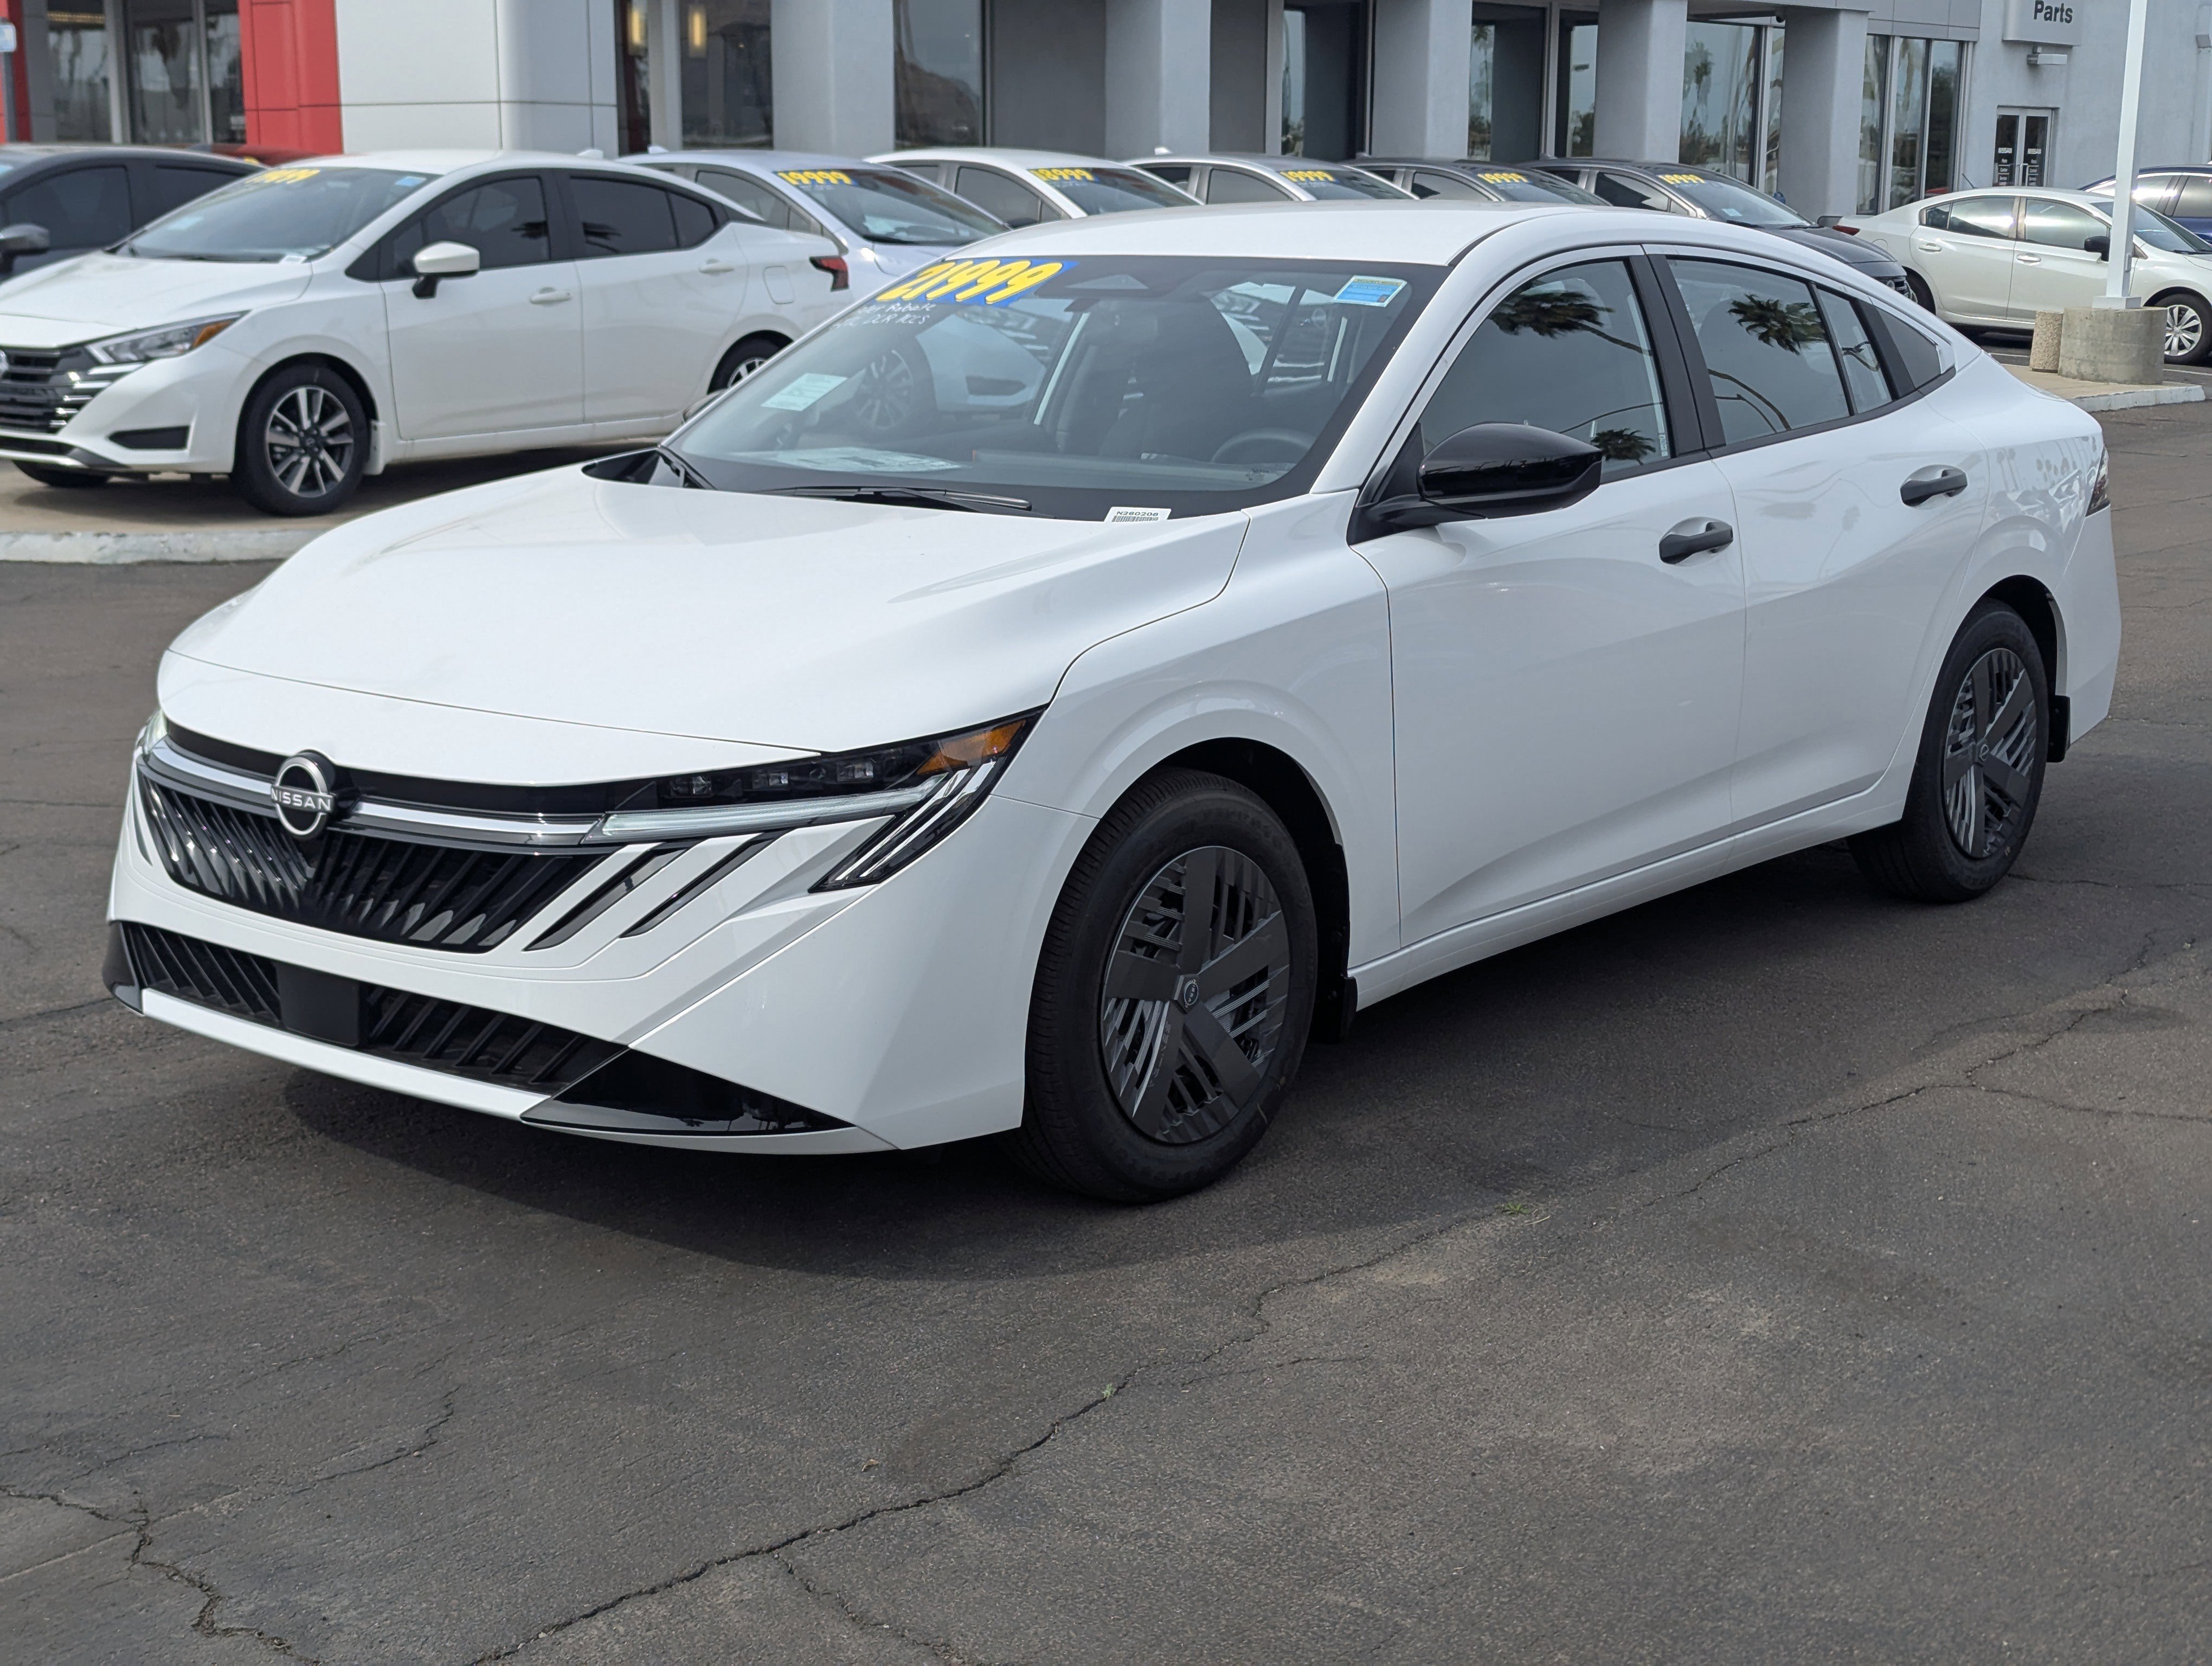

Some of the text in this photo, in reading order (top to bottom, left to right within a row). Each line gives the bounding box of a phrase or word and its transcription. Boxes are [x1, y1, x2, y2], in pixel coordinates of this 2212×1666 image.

[2034, 0, 2073, 24] Parts
[777, 171, 853, 185] 19999
[875, 259, 1063, 305] 21999
[271, 788, 331, 811] NISSAN
